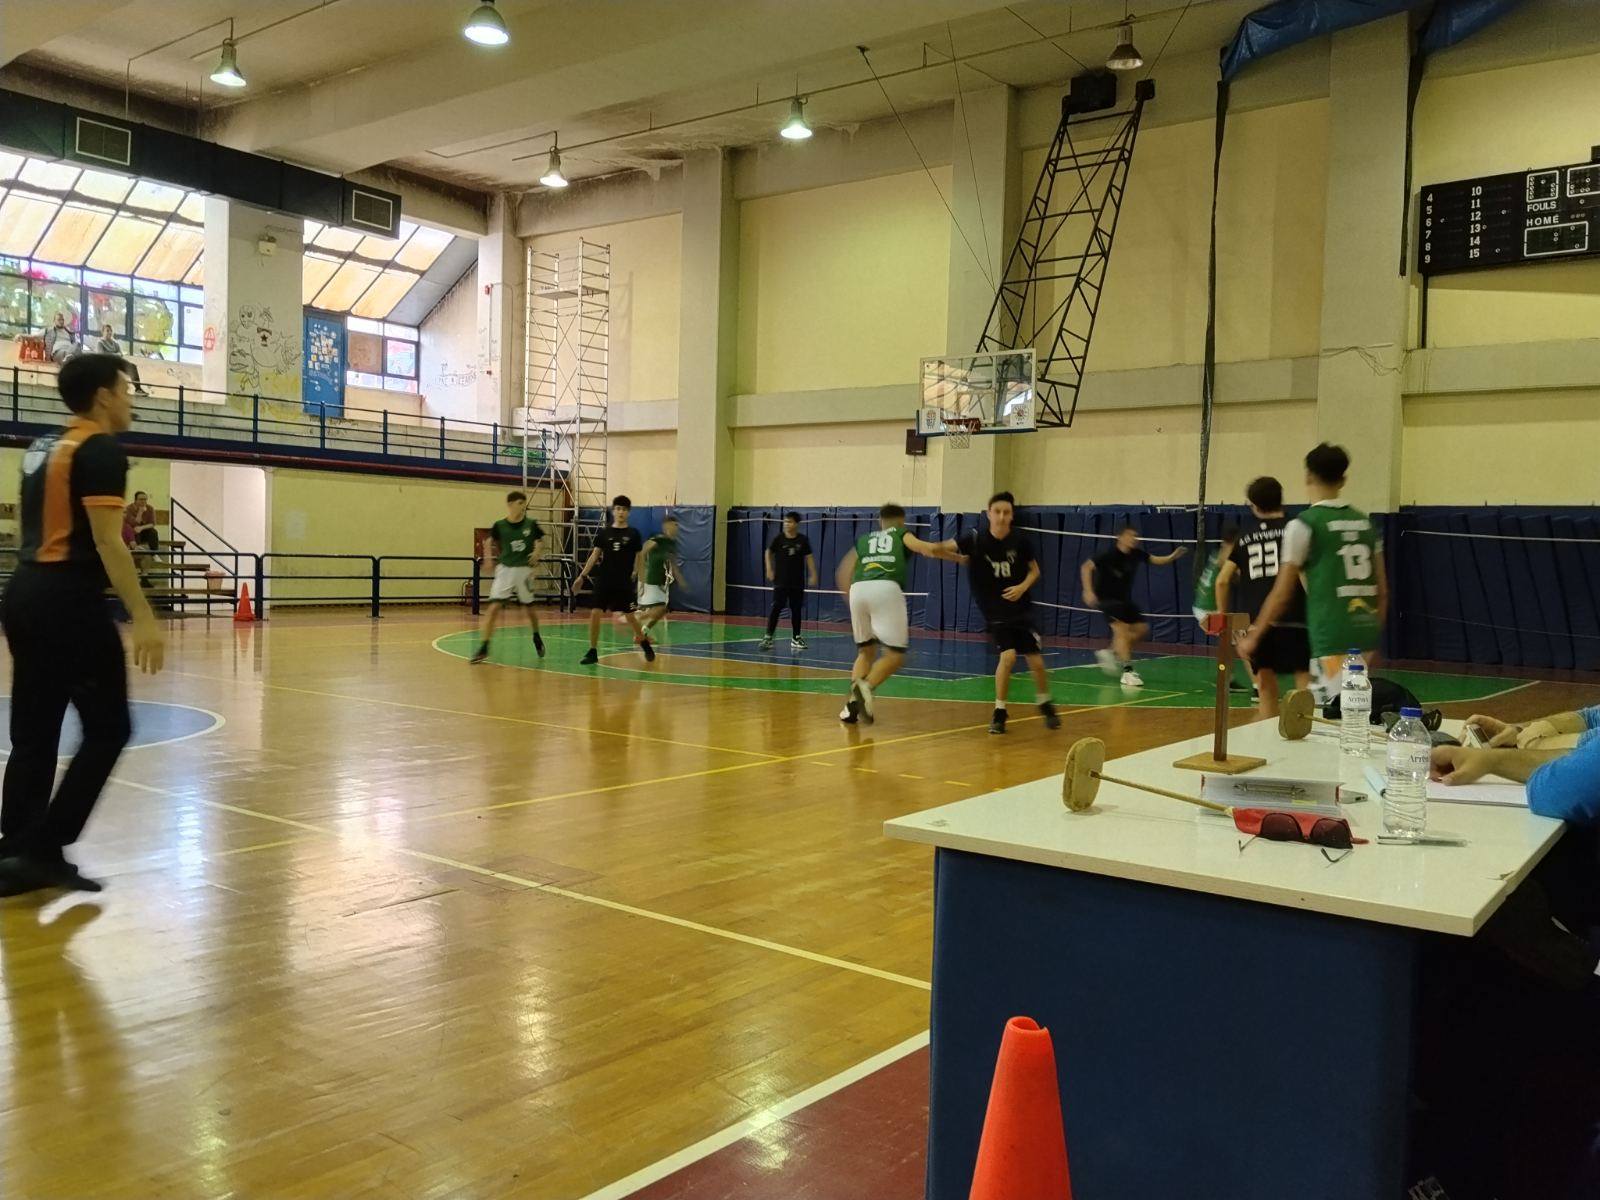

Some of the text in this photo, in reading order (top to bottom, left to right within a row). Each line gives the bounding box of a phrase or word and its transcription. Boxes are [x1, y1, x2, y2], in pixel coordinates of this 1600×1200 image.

[1471, 185, 1483, 197] 10
[1426, 192, 1434, 203] 4
[1470, 198, 1481, 209] 11
[1425, 205, 1433, 215] 5
[1526, 200, 1557, 213] FOULS
[1425, 217, 1432, 227] 6
[1470, 210, 1482, 222] 12
[1526, 214, 1560, 227] HOME
[1425, 229, 1432, 240] 7
[1469, 223, 1481, 234] 13
[1424, 242, 1432, 252] 8
[1469, 235, 1481, 247] 14
[1424, 254, 1431, 264] 9
[1468, 247, 1480, 259] 15
[867, 534, 894, 554] 19
[1247, 540, 1279, 580] 23
[1336, 543, 1373, 580] 13
